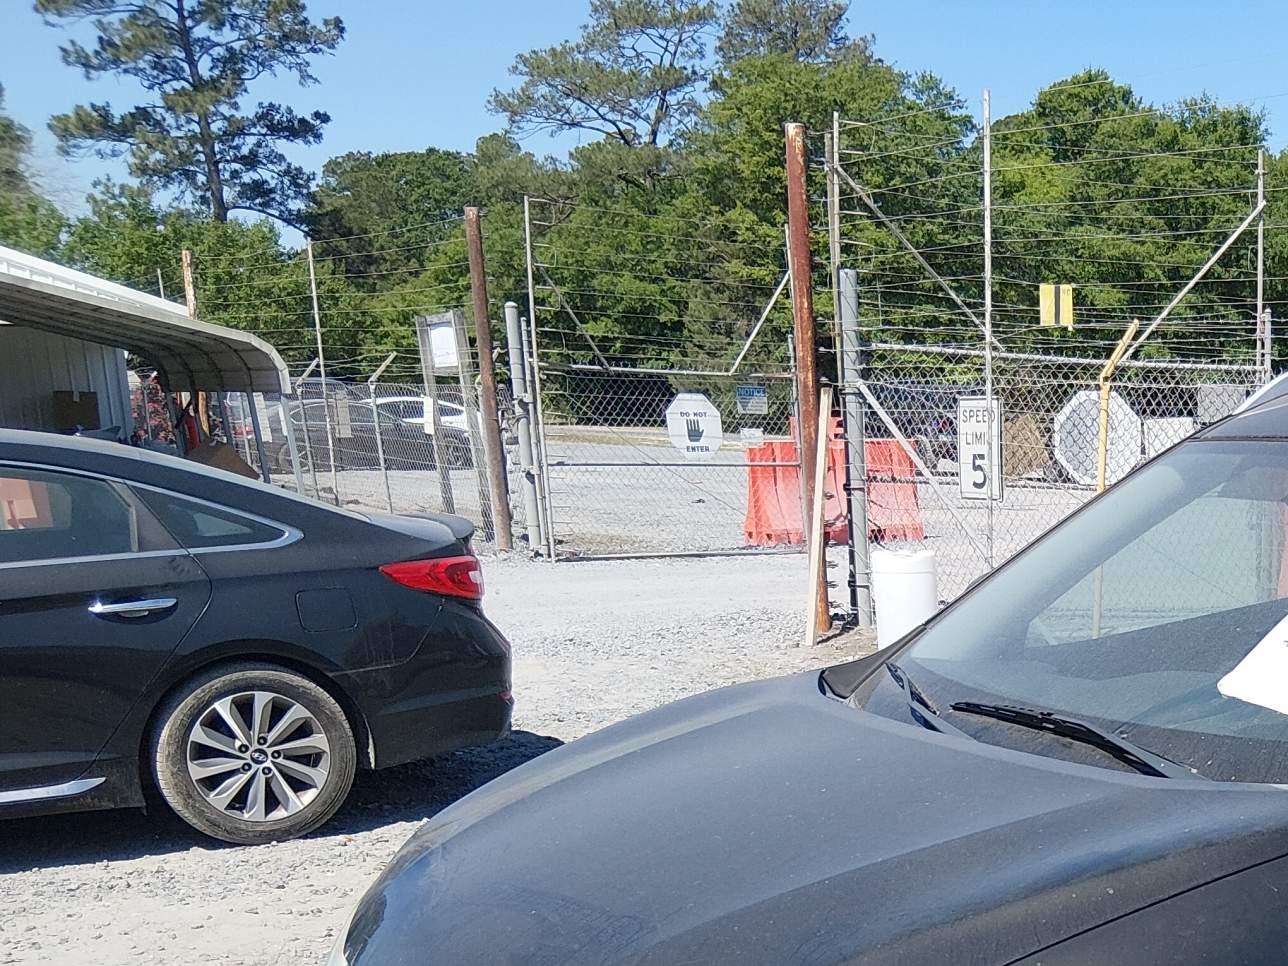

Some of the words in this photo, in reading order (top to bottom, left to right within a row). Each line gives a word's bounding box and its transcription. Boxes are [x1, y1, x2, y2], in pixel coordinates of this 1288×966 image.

[962, 409, 996, 423] SPEED
[965, 432, 989, 446] LIMI
[686, 445, 710, 453] ENTER
[972, 453, 987, 489] 5
